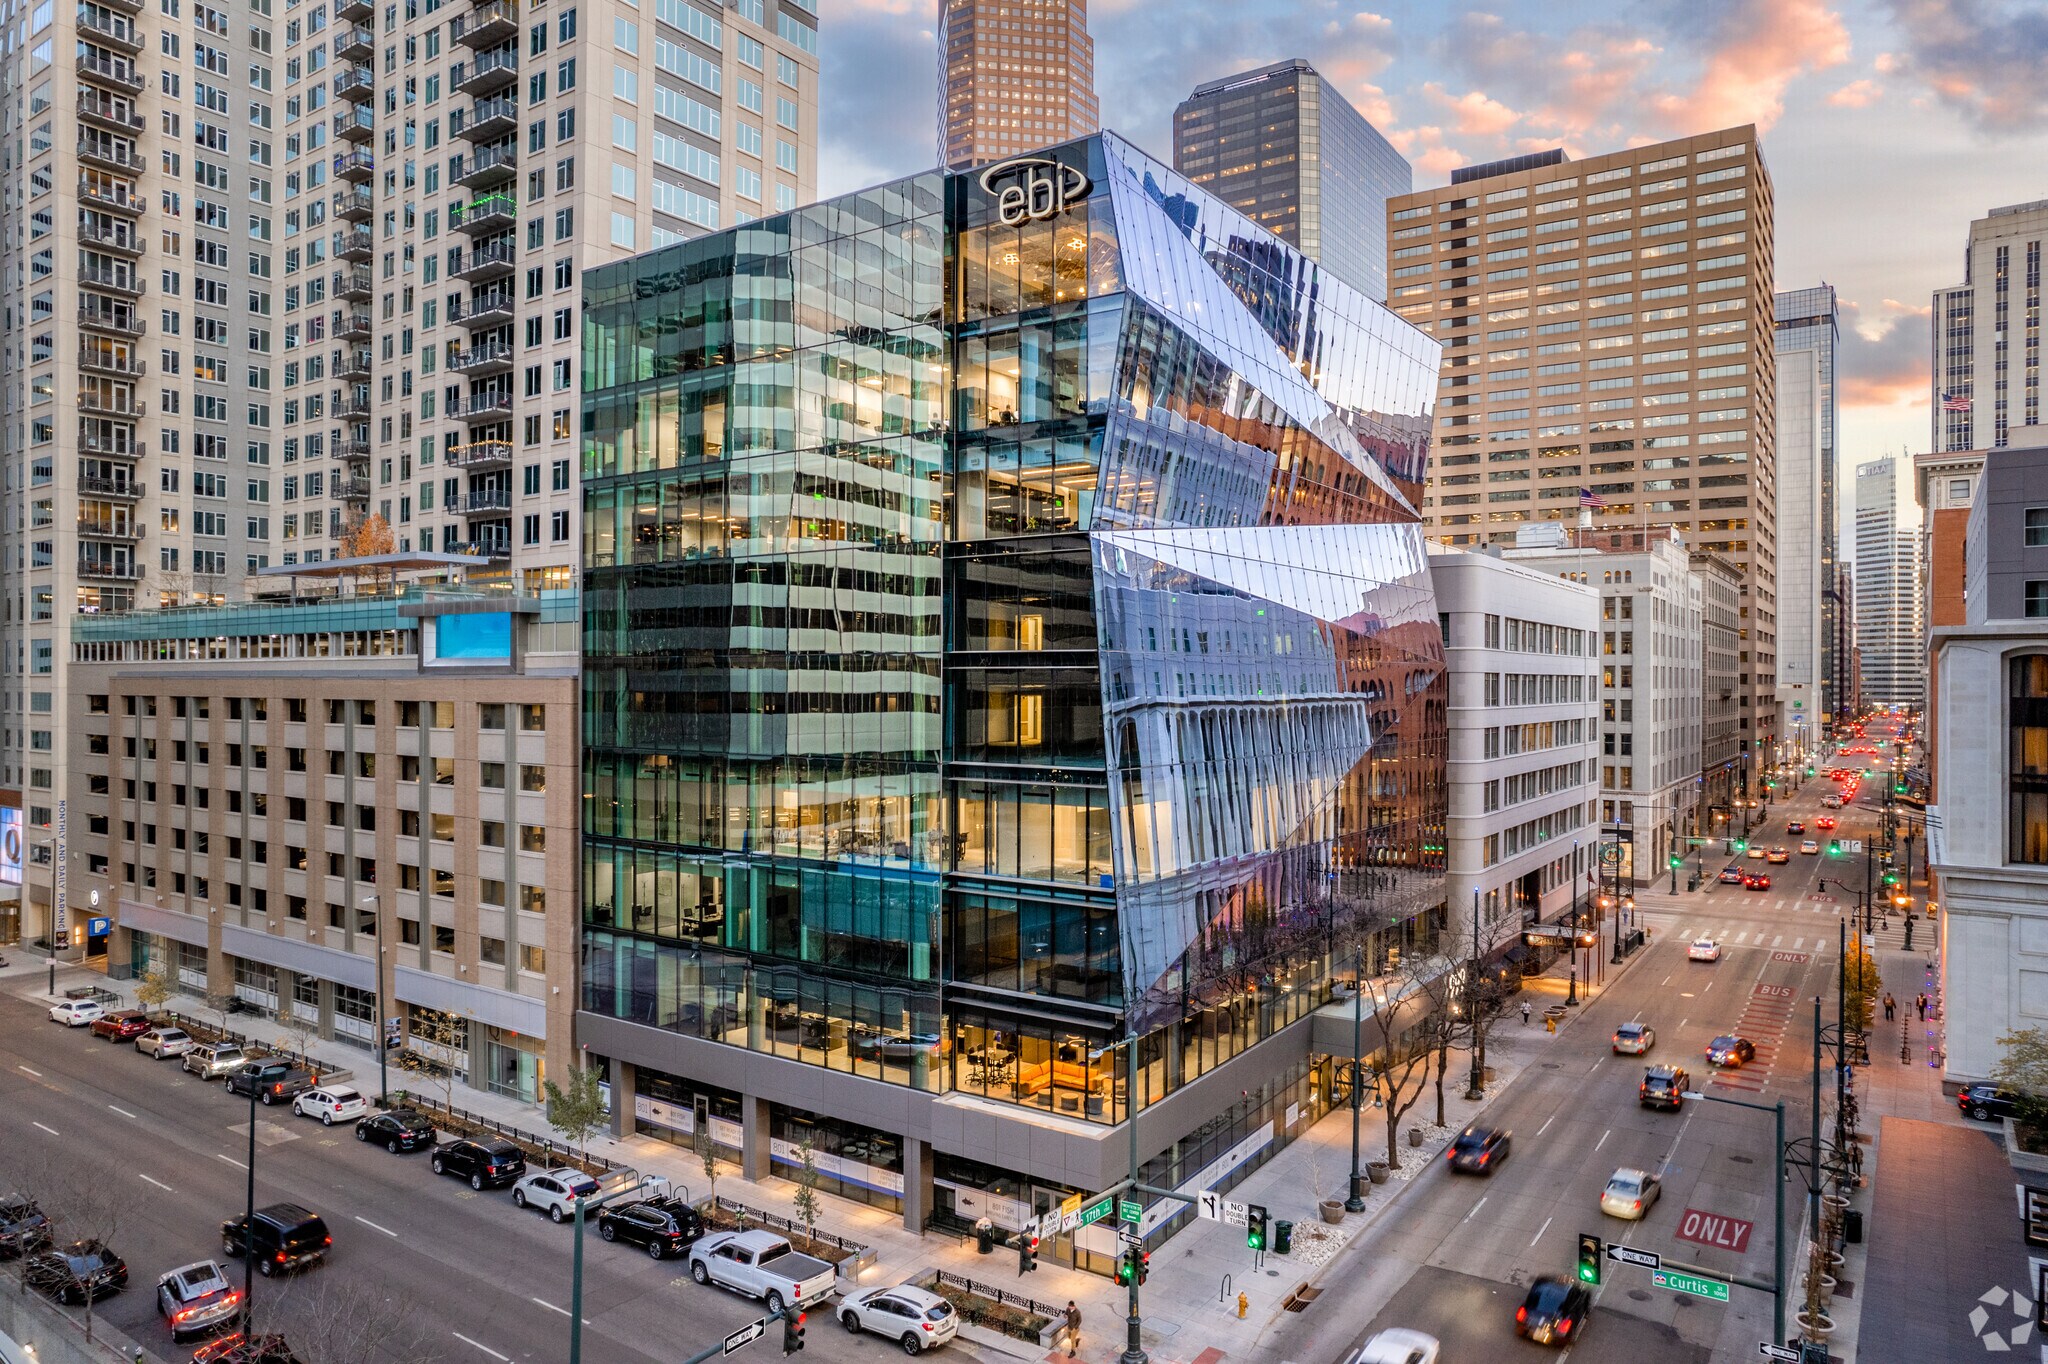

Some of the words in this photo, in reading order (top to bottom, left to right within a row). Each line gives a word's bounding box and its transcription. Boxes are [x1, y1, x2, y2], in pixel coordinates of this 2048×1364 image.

[999, 162, 1065, 225] ebi
[1866, 465, 1887, 477] TIAA
[58, 800, 66, 839] MONTHLY
[58, 844, 66, 862] AND
[58, 866, 66, 890] DAILY
[1811, 895, 1833, 903] BUS
[58, 893, 66, 929] PARKING
[95, 920, 107, 934] P
[1774, 953, 1807, 963] ONLY
[1761, 985, 1791, 997] BUS
[637, 1102, 648, 1114] 801
[773, 1142, 785, 1155] 801
[1002, 1205, 1014, 1215] FISH
[1230, 1203, 1244, 1212] NO
[1048, 1211, 1058, 1222] NO
[1085, 1207, 1101, 1223] 17th
[1226, 1210, 1248, 1221] DOUBLE
[1044, 1218, 1060, 1231] DOUBLE
[1229, 1218, 1246, 1227] TURN
[1045, 1226, 1057, 1235] TURN
[1683, 1213, 1747, 1247] ONLY
[1622, 1251, 1637, 1260] ONE
[1639, 1256, 1655, 1264] WAY
[1670, 1276, 1708, 1294] Curtis
[1714, 1290, 1727, 1298] 1000
[728, 1336, 740, 1348] ONE
[740, 1329, 753, 1341] WAY
